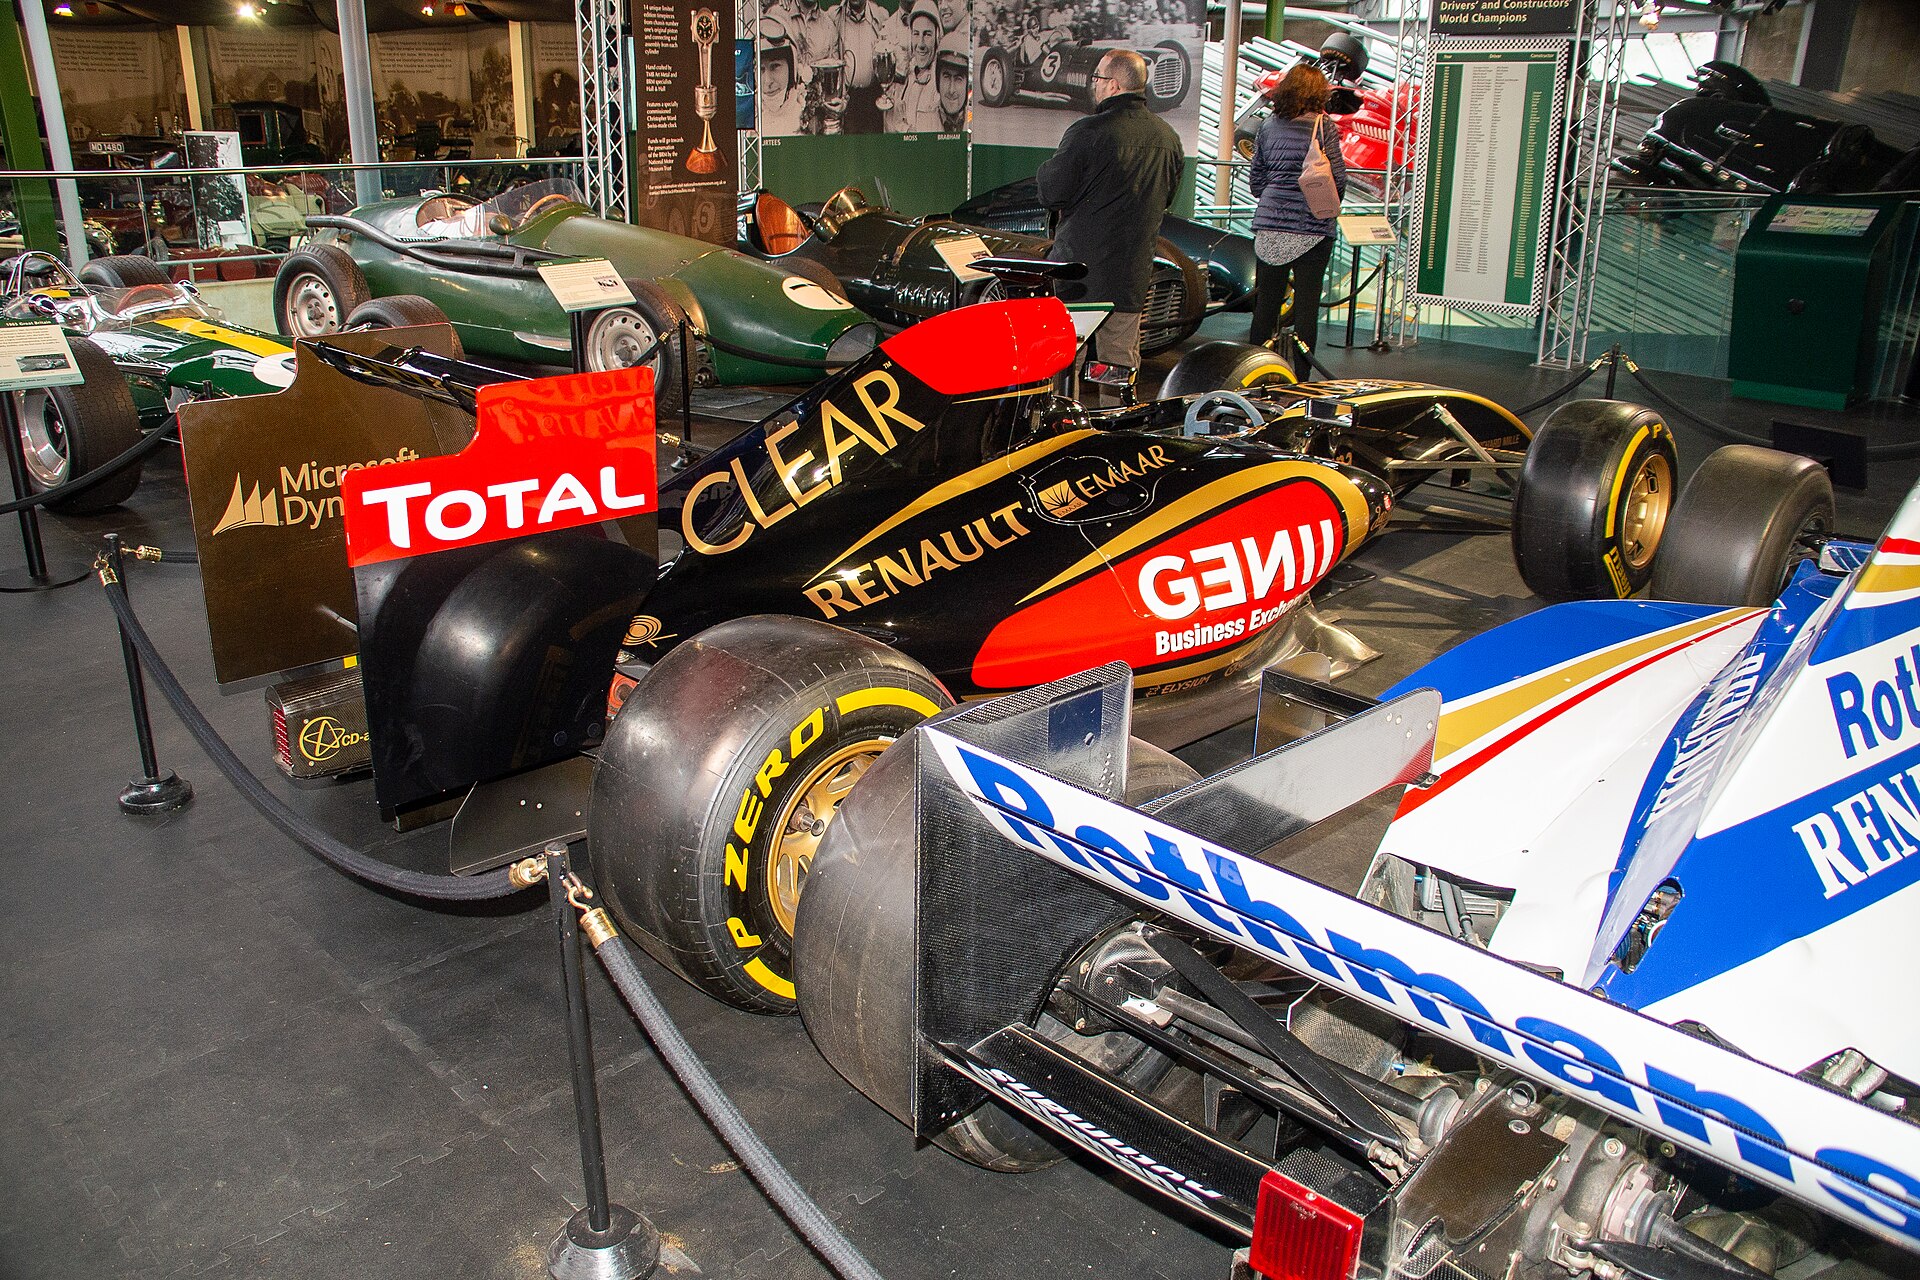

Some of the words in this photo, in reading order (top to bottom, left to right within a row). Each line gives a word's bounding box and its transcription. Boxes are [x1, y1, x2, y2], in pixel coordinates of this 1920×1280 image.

[1440, 13, 1469, 23] World
[1471, 13, 1527, 25] Champions
[1481, 0, 1500, 9] and
[681, 369, 925, 555] CLEAR
[1076, 445, 1176, 499] EMAAR
[362, 466, 645, 549] TOTAL
[803, 501, 1031, 619] RENAULT
[1155, 617, 1246, 656] Business
[1161, 674, 1212, 695] ELYSIUM
[724, 706, 825, 892] ZERO
